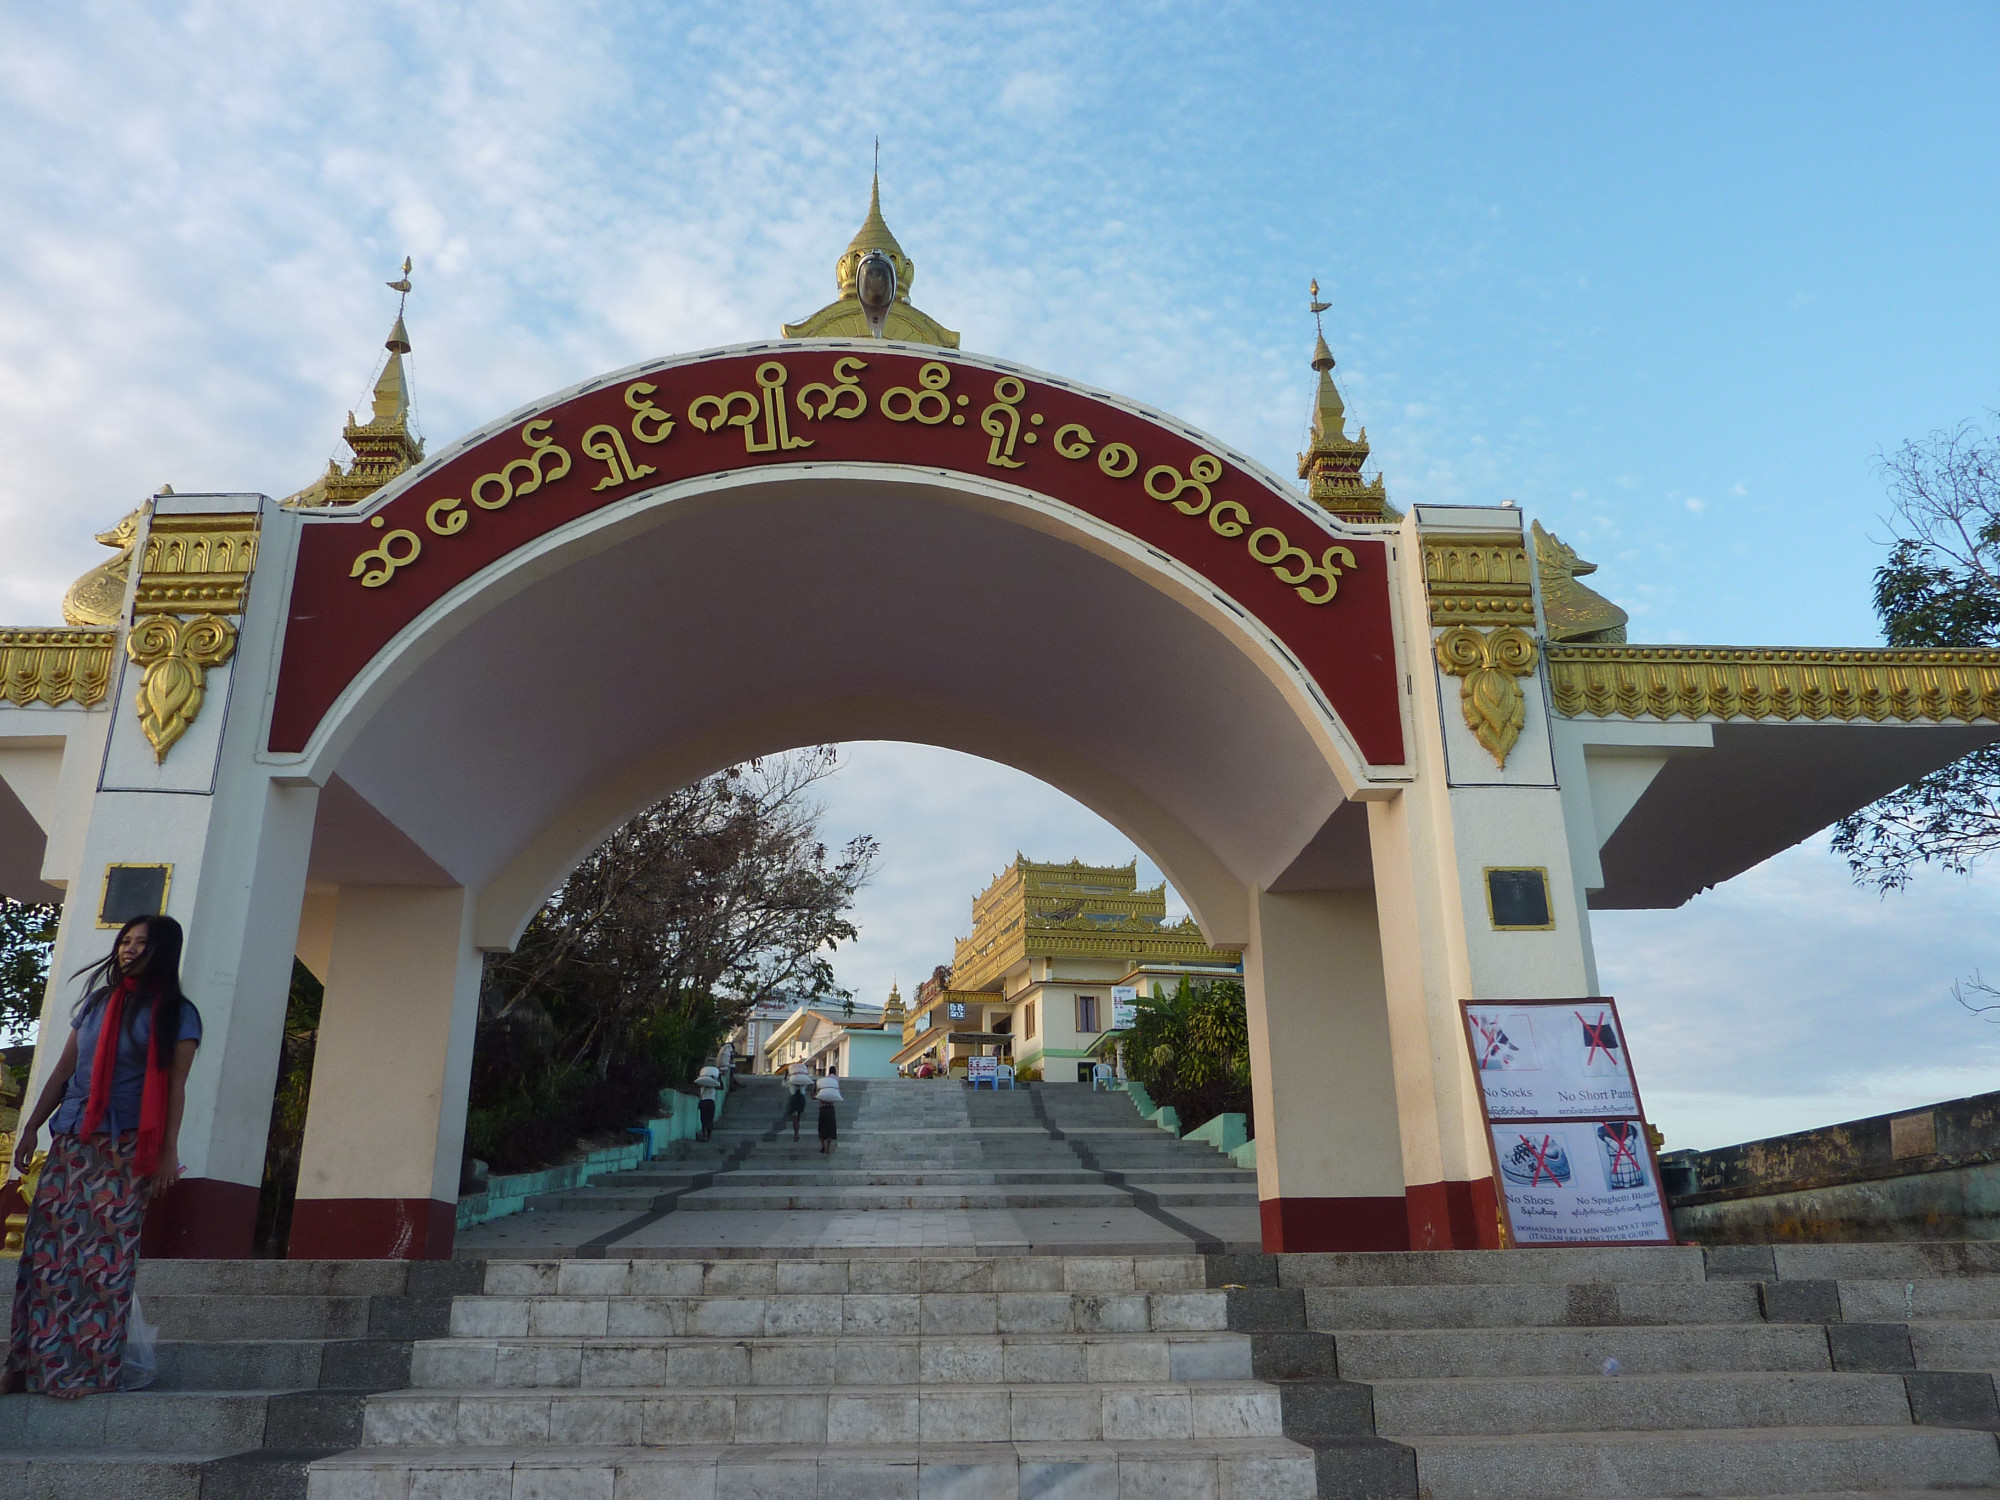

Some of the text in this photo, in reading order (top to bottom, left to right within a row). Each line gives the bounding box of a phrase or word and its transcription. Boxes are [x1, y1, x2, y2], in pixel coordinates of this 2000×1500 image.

[1483, 1087, 1533, 1097] No Socks
[1558, 1091, 1575, 1101] No
[1579, 1090, 1608, 1101] Short
[1506, 1194, 1554, 1205] No Shoes
[1576, 1197, 1589, 1205] No
[1592, 1195, 1630, 1206] Spaghetti
[1517, 1225, 1555, 1233] DONATED
[1601, 1225, 1616, 1233] MIN
[1642, 1220, 1658, 1229] THIN
[1529, 1233, 1563, 1241] (ITALIAN
[1629, 1230, 1654, 1239] GUIDE)
